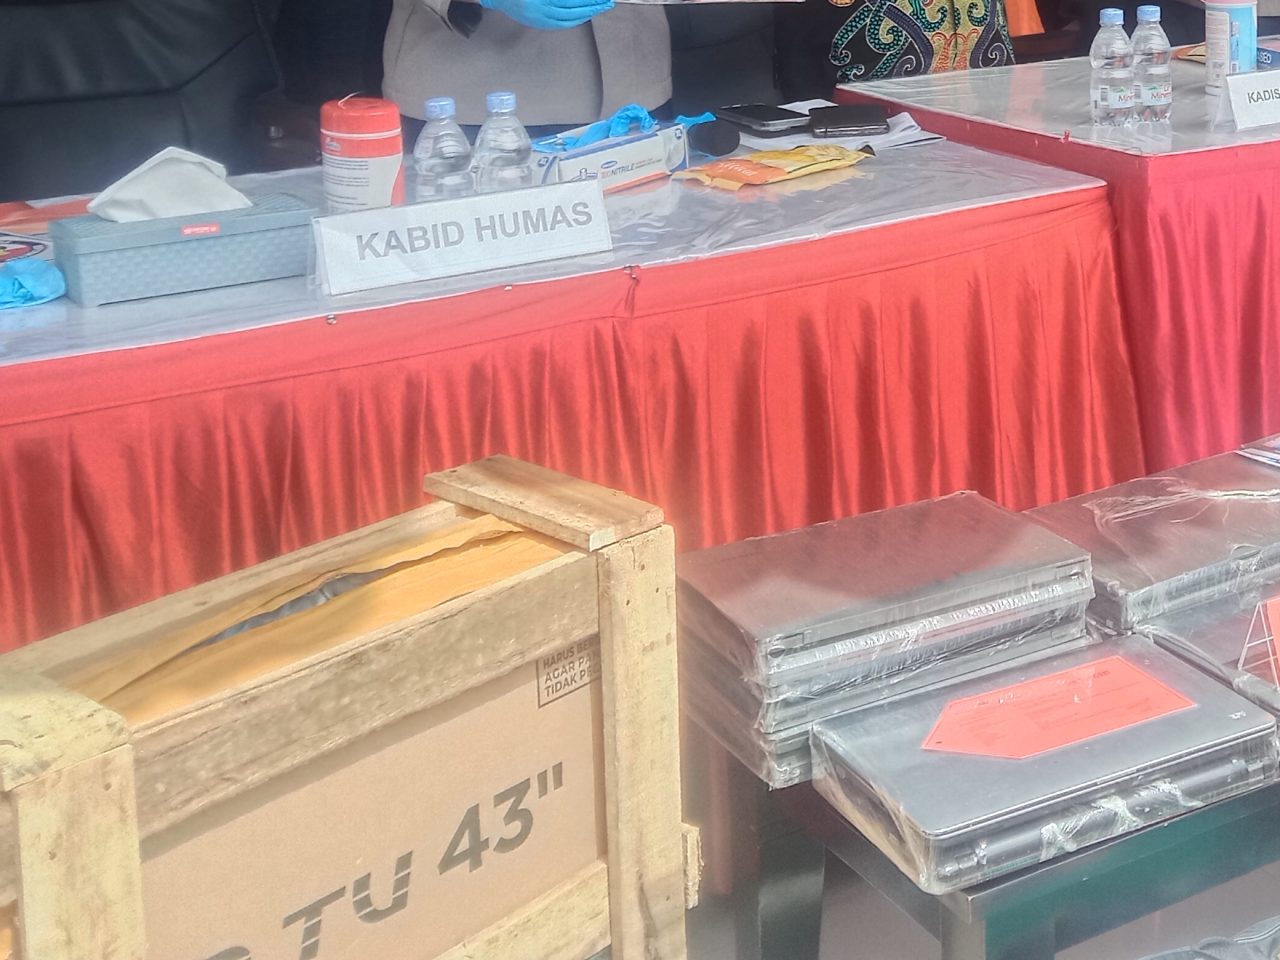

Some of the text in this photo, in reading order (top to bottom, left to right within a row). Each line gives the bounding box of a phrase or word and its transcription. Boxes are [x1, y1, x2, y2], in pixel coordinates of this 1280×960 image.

[355, 200, 594, 262] KABID HUMAS
[543, 646, 575, 670] HARUS
[543, 672, 577, 698] TIDAK
[544, 660, 576, 685] AGAR
